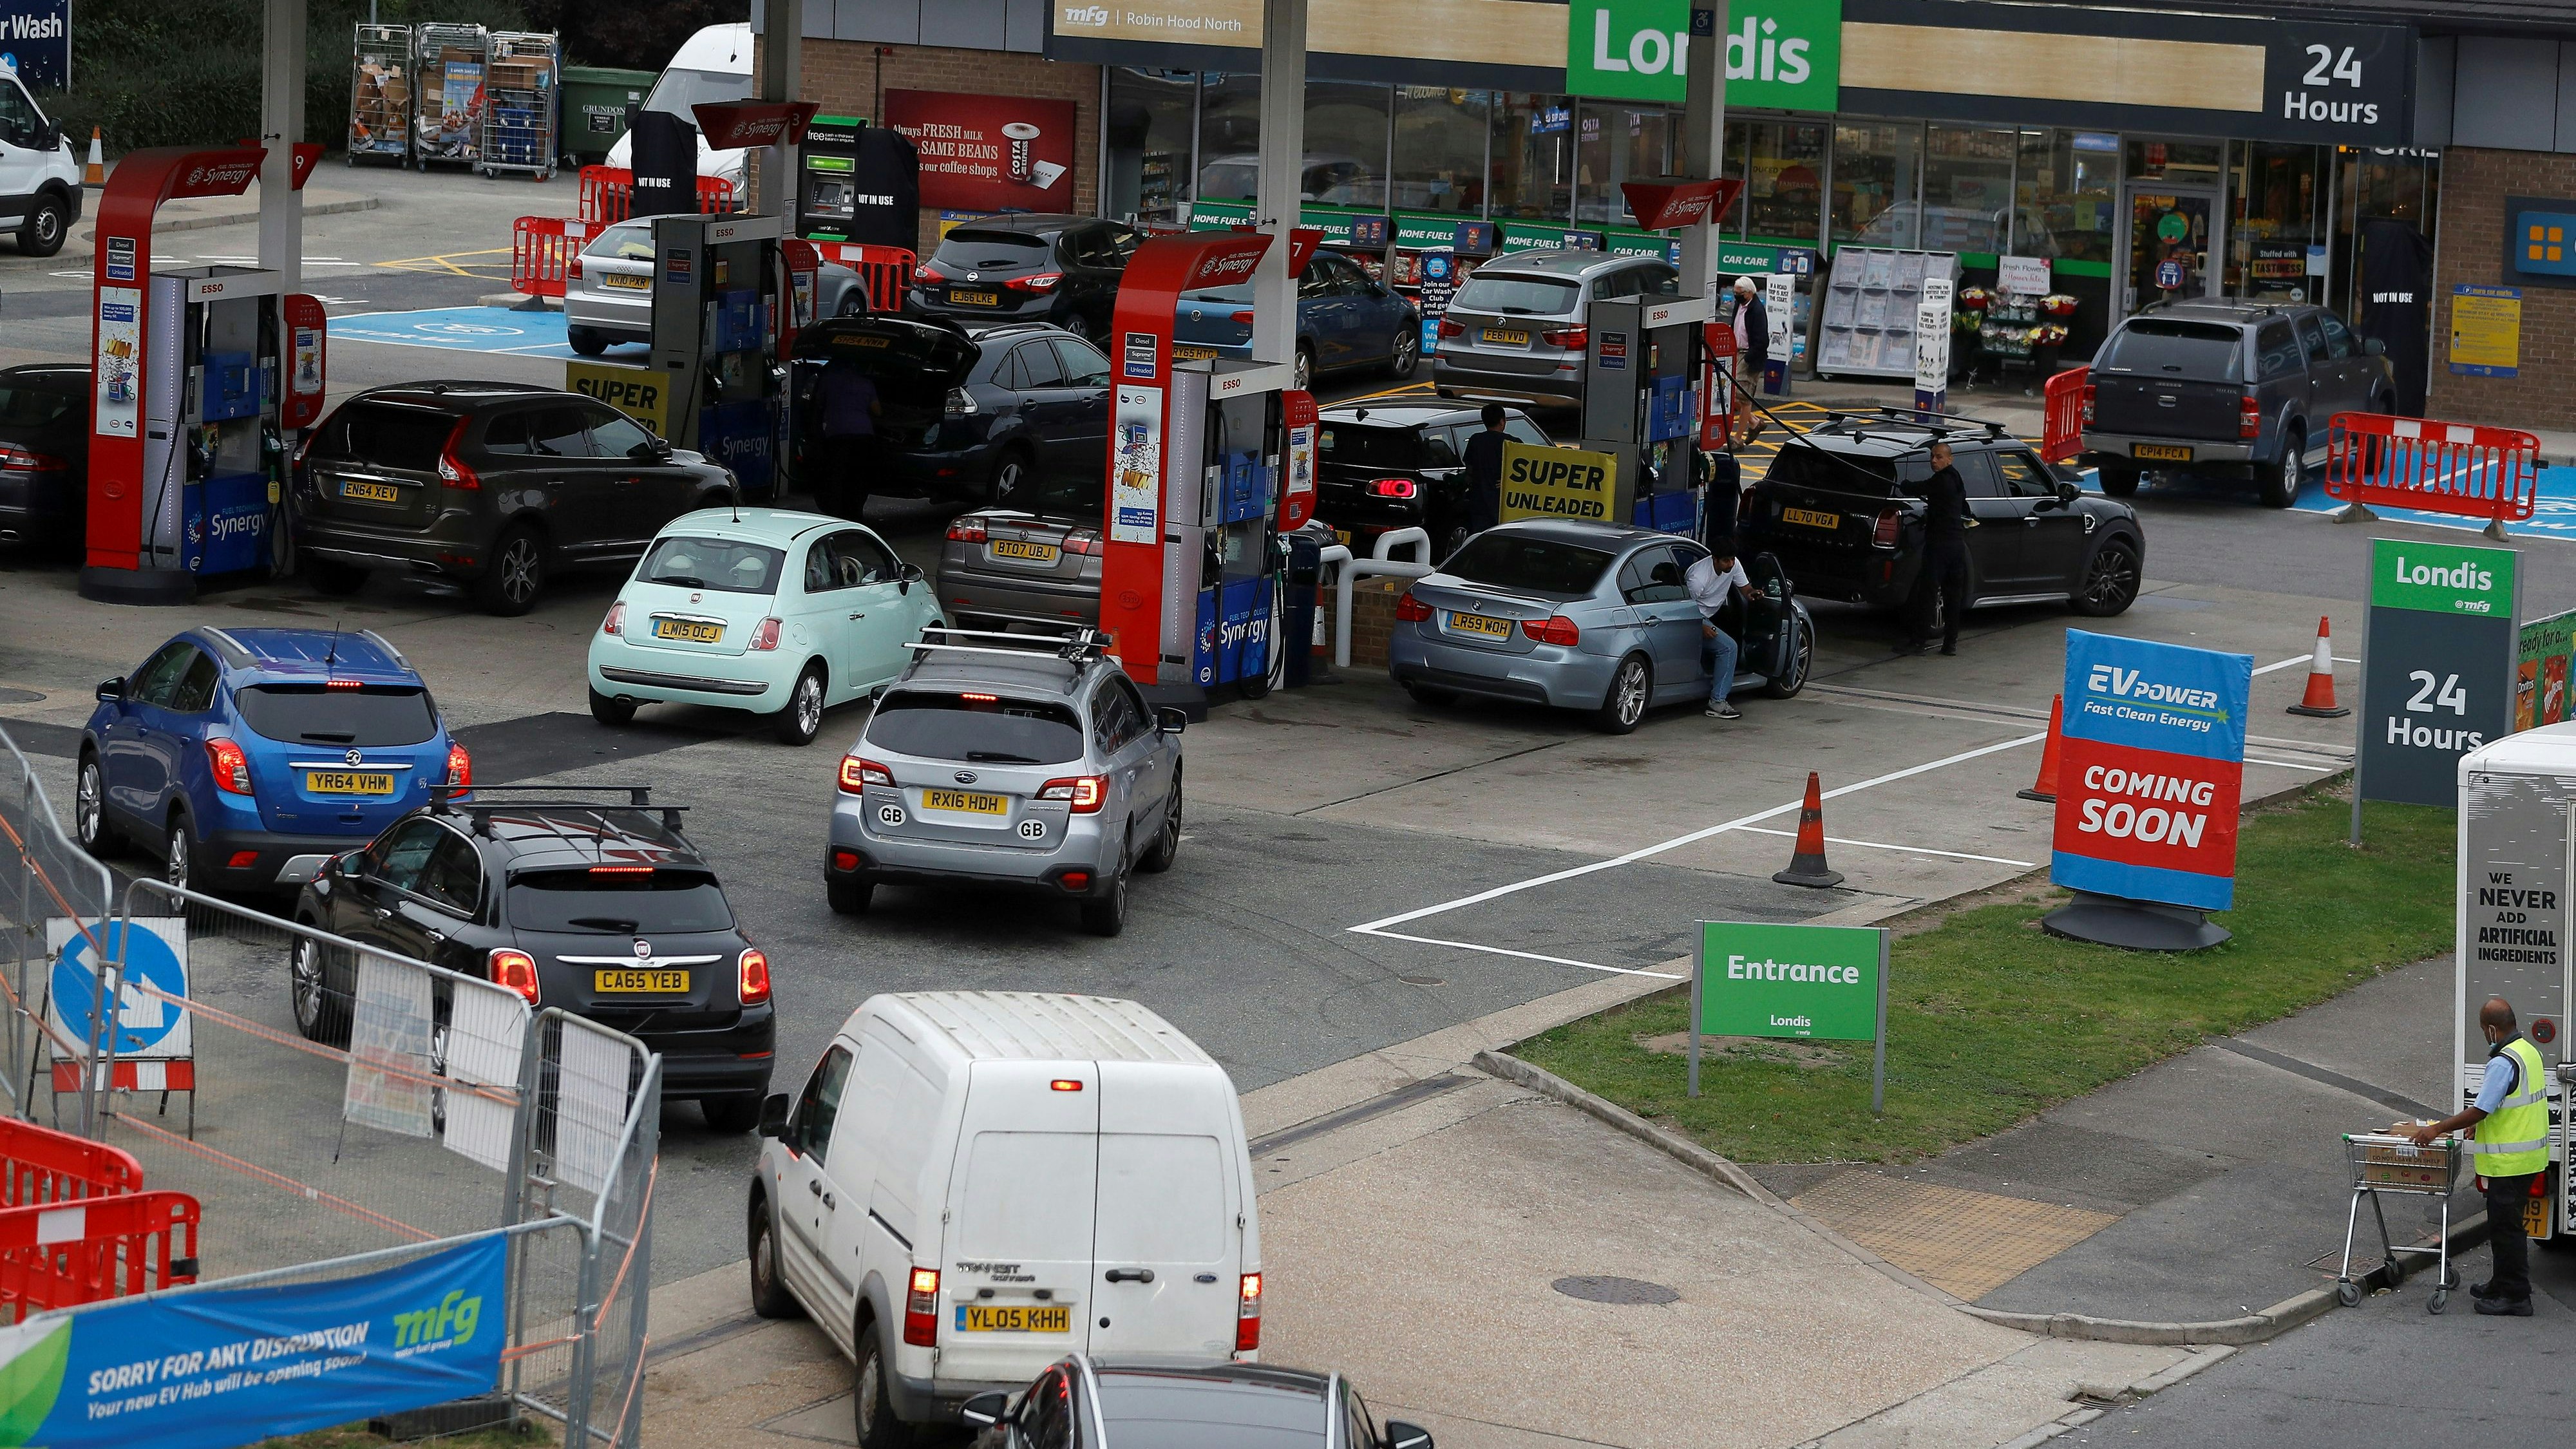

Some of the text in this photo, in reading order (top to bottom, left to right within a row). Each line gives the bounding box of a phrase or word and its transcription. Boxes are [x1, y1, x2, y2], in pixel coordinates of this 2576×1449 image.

[11, 12, 62, 39] Wash
[1065, 5, 1242, 32] mfg Robin Hood North
[2302, 44, 2362, 88] 24
[582, 104, 626, 115] GRUNDON
[2284, 91, 2378, 126] Hours
[792, 113, 800, 126] 3
[745, 121, 784, 138] Synergy
[808, 129, 825, 141] free
[922, 123, 983, 141] FRESH MILK
[921, 140, 998, 160] SAME BEANS
[1012, 140, 1021, 175] COSTA
[295, 155, 304, 169] 9
[925, 162, 998, 178] our coffee shops
[204, 168, 251, 185] Synergy
[649, 177, 671, 188] IN USE
[869, 194, 894, 205] IN USE
[1675, 198, 1709, 216] Synergy
[1193, 214, 1247, 225] HOME FUELS
[715, 228, 734, 238] ESSO
[1323, 225, 1350, 234] FUELS
[1398, 229, 1454, 240] HOME FUELS
[1293, 242, 1303, 257] 7
[1506, 236, 1561, 249] HOME FUELS
[1613, 247, 1660, 258] CAR CARE
[1722, 254, 1769, 267] CAR CARE
[1214, 257, 1256, 276] Synergy
[2254, 262, 2302, 274] TASTINESS
[202, 283, 223, 294] ESSO
[609, 275, 647, 288] VK10 PXR
[953, 292, 993, 303] EJ66 LKE
[2372, 292, 2413, 303] NOT IN USE
[1653, 310, 1669, 320] ESSO
[737, 339, 741, 348] 3
[1486, 330, 1525, 341] FE61 VVD
[104, 339, 133, 359] WIN
[1173, 348, 1214, 359] RY65 HTG
[1222, 378, 1241, 390] ESSO
[576, 377, 659, 410] SUPER
[230, 407, 235, 417] 9
[1669, 427, 1672, 437] 1
[723, 435, 769, 460] Synergy
[2140, 446, 2184, 459] CP14 FCA
[1121, 468, 1153, 490] WIN
[1508, 457, 1605, 492] SUPER
[345, 483, 397, 499] EN64 XEV
[1239, 507, 1245, 518] 7
[1506, 491, 1605, 518] UNLEADED
[1660, 518, 1694, 531] FUEL TECHNOLOGY
[1786, 509, 1812, 523] LL70
[1815, 513, 1833, 526] VGA
[211, 513, 270, 541] Synergy
[998, 542, 1052, 558] BT07 UBJ
[2396, 556, 2492, 591] Londis
[2454, 600, 2491, 612] @ mfg
[1229, 612, 1240, 622] FUEL
[661, 623, 718, 639] LM15 OCJ
[1220, 618, 1268, 649] Synergy
[1453, 618, 1508, 635] LR59 WOH
[2519, 628, 2554, 654] ready for
[2406, 670, 2467, 716] 24
[2517, 678, 2534, 694] Doritos
[2083, 701, 2211, 733] Fast Clean Energy
[2387, 715, 2483, 752] Hours
[314, 773, 388, 791] YR64 VHM
[2084, 764, 2215, 806] COMING
[931, 791, 998, 811] RX16 HDH
[880, 807, 902, 823] GB
[1020, 822, 1043, 837] GB
[2078, 798, 2208, 849] SOON
[2488, 871, 2512, 885] WE
[2479, 887, 2556, 910] NEVER
[2496, 911, 2527, 924] ADD
[2478, 926, 2557, 947] ARTIFICIAL
[2477, 947, 2557, 965] INGREDIENTS
[1727, 954, 1859, 984] Entrance
[603, 972, 681, 989] CA65 YEB
[1770, 1014, 1812, 1027] Londis
[956, 1262, 1021, 1274] TRANSIT
[393, 1289, 482, 1348] mfg
[969, 1308, 1066, 1329] YL05 KHH
[395, 1338, 453, 1358] motor fuel group
[87, 1320, 370, 1396] SORRY FOR ANY DISRUPTION
[87, 1359, 322, 1421] Your new EV Hub will be opening
